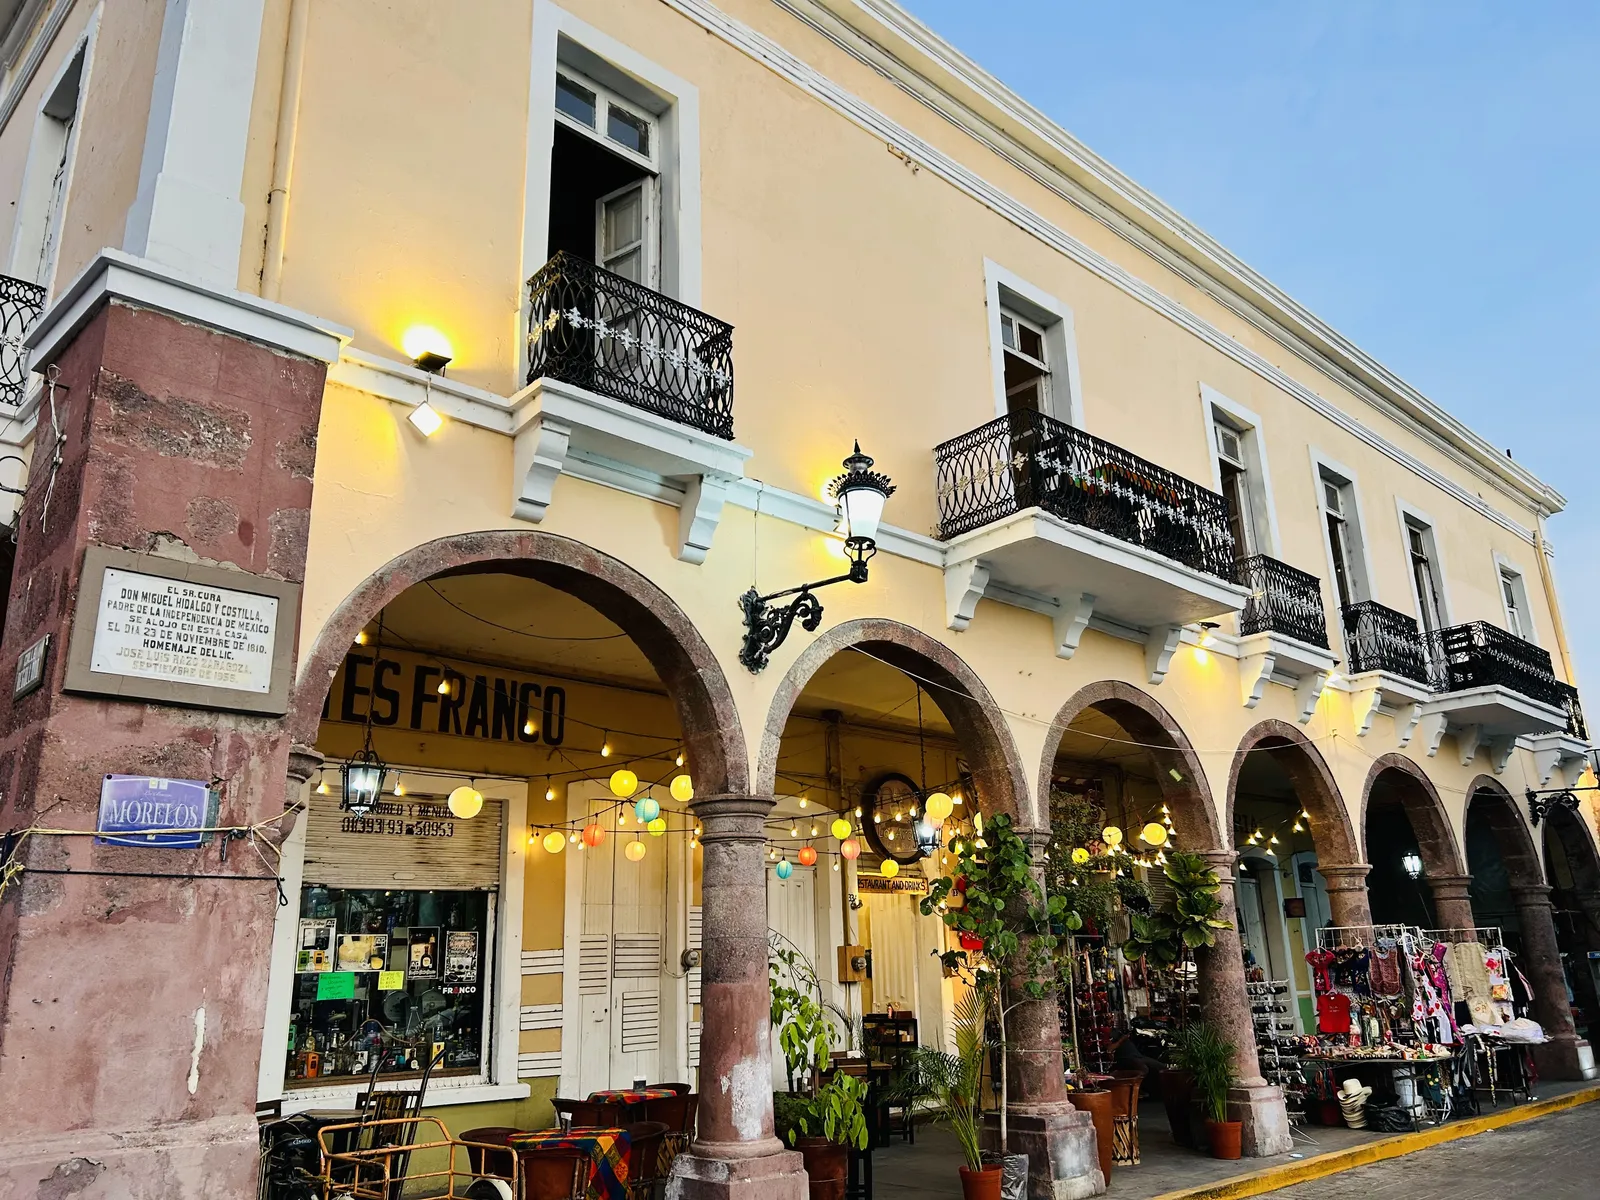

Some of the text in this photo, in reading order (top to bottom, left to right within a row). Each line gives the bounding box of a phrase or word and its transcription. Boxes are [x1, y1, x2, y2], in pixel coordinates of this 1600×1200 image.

[167, 586, 179, 595] EL
[120, 587, 263, 623] DON MIGUEL HIDALGO Y COSTILLA,
[107, 600, 270, 635] PADRE DE LA INDEPENDENCIA DE MEXICO
[129, 614, 248, 640] SE ALOJO EN ESTA CASA
[106, 621, 121, 633] EL
[124, 623, 141, 635] DIA
[143, 627, 157, 638] 23
[159, 629, 173, 640] DE
[175, 631, 231, 649] NOVIEMBRE
[232, 640, 245, 651] DE
[142, 638, 235, 661] HOMENAJE DEL LIC.
[198, 667, 213, 680] DE
[409, 664, 567, 747] FRANCO
[107, 798, 199, 828] MORELOS
[407, 803, 415, 817] Y
[858, 878, 891, 890] ESTAURANT
[891, 879, 905, 891] AND
[442, 986, 477, 995] FRANCO
